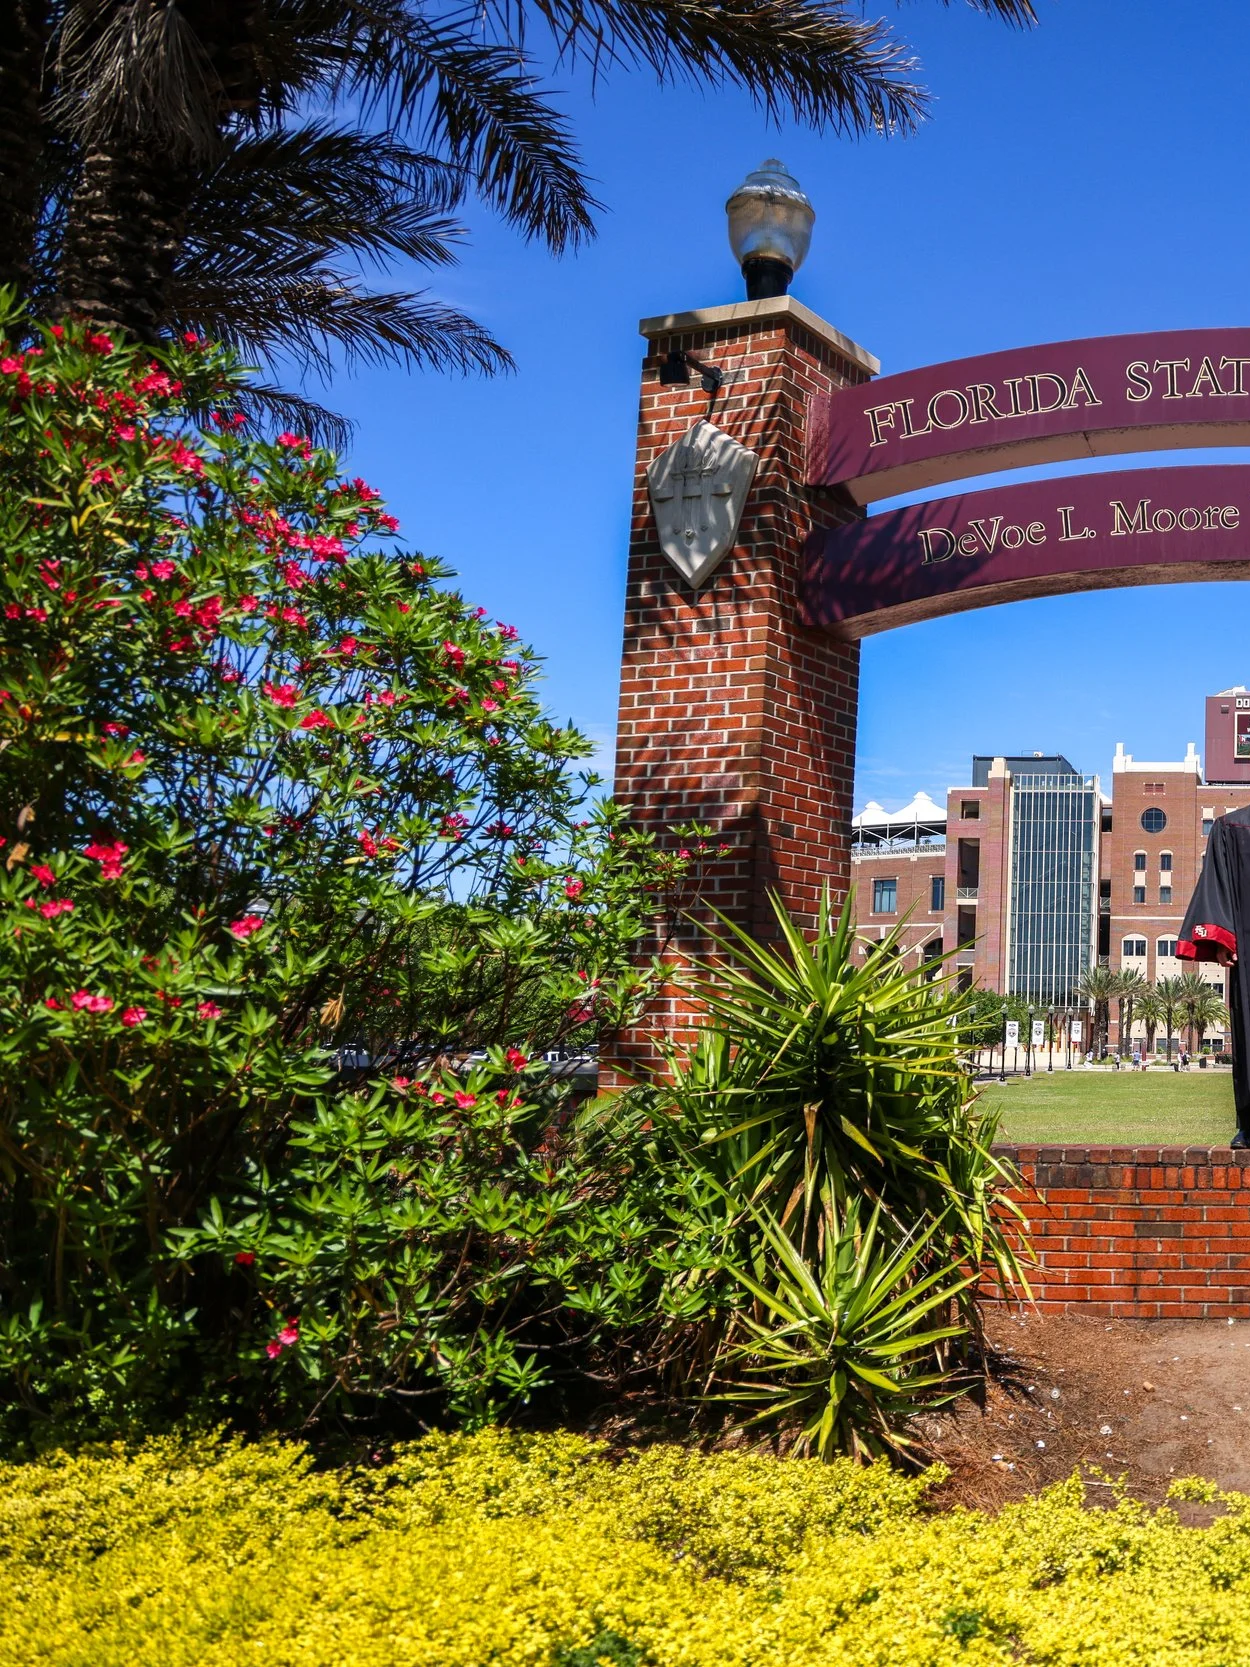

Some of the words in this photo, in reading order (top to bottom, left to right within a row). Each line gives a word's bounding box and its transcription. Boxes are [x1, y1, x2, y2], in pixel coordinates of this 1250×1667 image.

[864, 367, 1102, 447] FLORIDA
[918, 516, 1046, 565] DeVoe
[1057, 506, 1097, 541] L.
[1110, 498, 1239, 535] Moore
[1194, 925, 1207, 938] FSU
